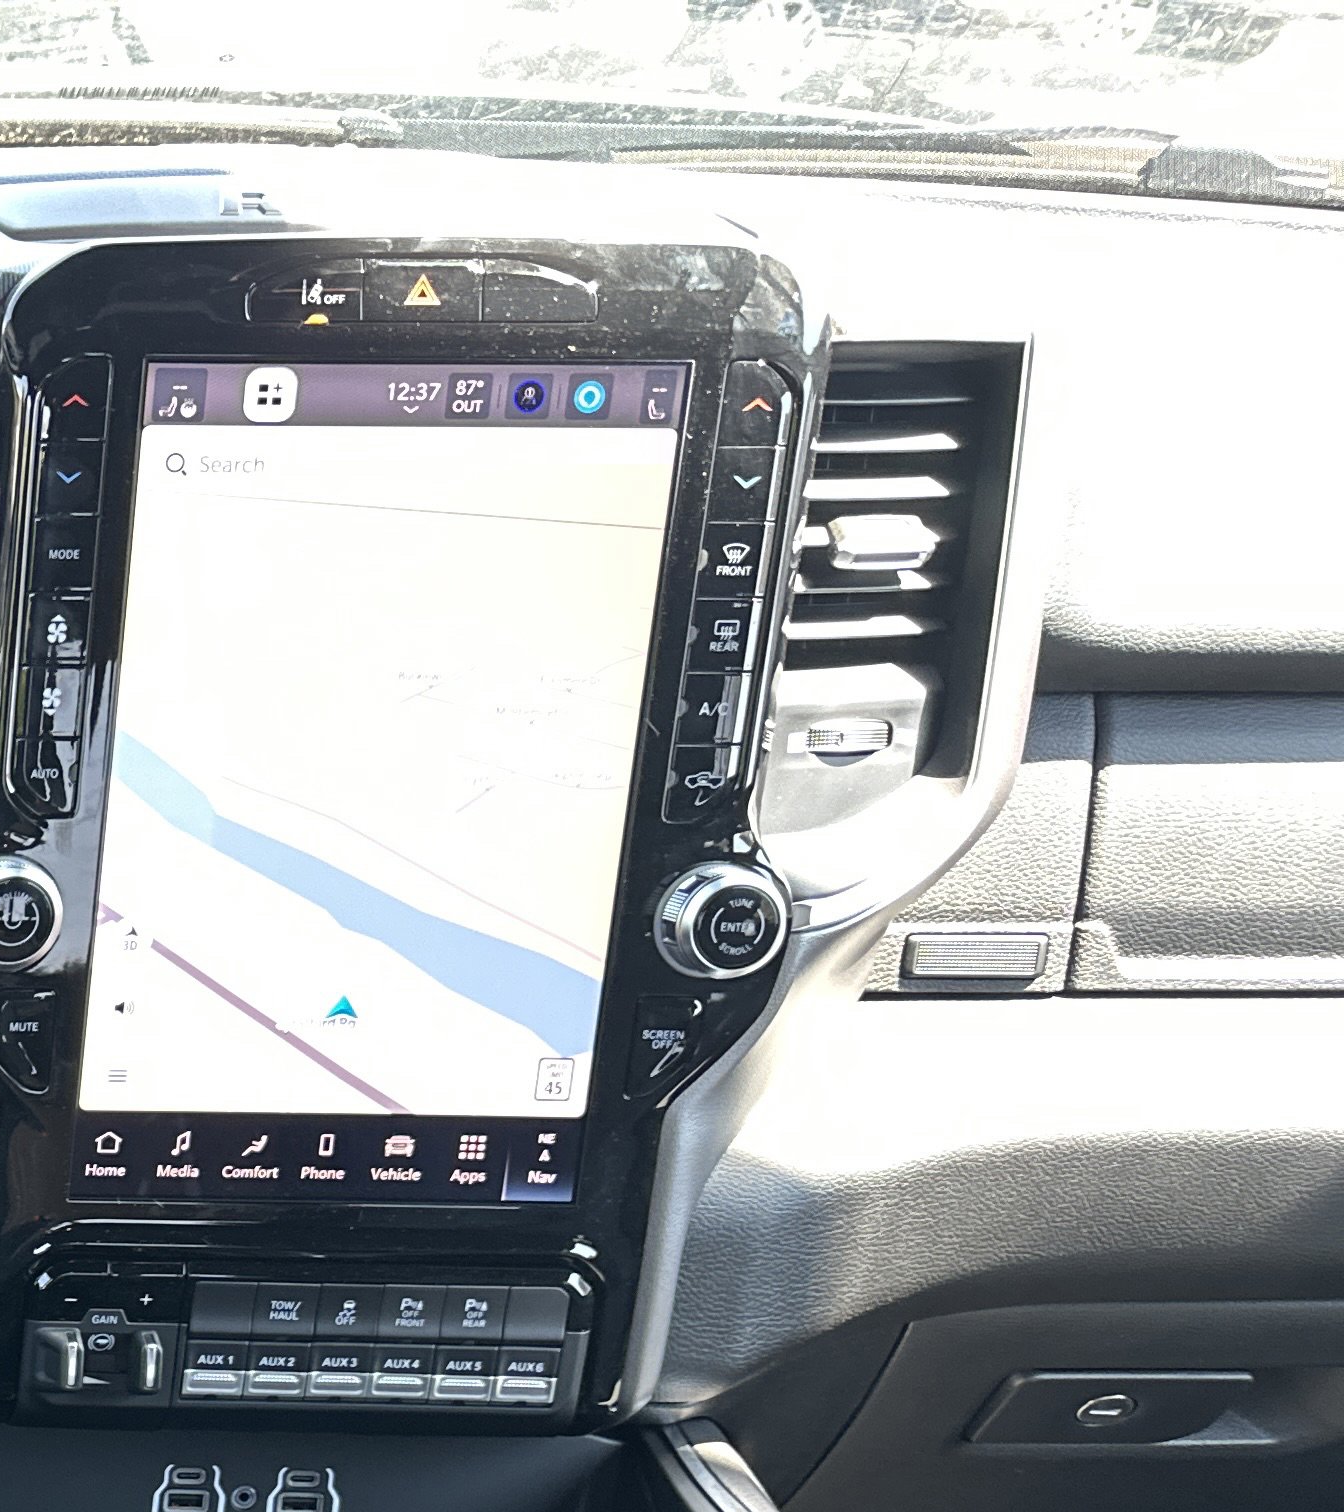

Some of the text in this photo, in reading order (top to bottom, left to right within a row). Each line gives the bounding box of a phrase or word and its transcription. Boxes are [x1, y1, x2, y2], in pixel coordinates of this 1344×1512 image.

[324, 291, 346, 305] OFF
[388, 382, 442, 402] 12:37
[455, 379, 484, 396] 87°
[452, 399, 483, 413] OUT
[199, 454, 265, 475] Search
[48, 548, 80, 560] MODE
[716, 565, 752, 577] FRONT
[709, 641, 739, 653] REAR
[698, 702, 728, 717] A/C
[30, 767, 59, 780] AUTO
[729, 899, 755, 911] TUNE
[123, 940, 138, 951] 3D
[718, 942, 753, 956] SCROLL
[9, 1021, 40, 1033] MUTE
[642, 1029, 685, 1041] SCREEN
[651, 1039, 673, 1050] OFF
[544, 1081, 562, 1095] 45
[537, 1133, 556, 1145] NE
[85, 1163, 126, 1178] Home
[156, 1164, 200, 1179] Media
[221, 1164, 279, 1180] Comfort
[300, 1165, 345, 1181] Phone
[370, 1166, 422, 1183] Vehicle
[449, 1168, 487, 1185] Apps
[527, 1170, 557, 1185] Nav
[270, 1300, 302, 1312] TOW/
[91, 1314, 118, 1325] GAIN
[269, 1311, 299, 1321] HAUL
[335, 1316, 356, 1326] OFF
[402, 1311, 419, 1319] OFF
[466, 1311, 483, 1319] OFF
[395, 1318, 425, 1328] FRONT
[463, 1319, 487, 1328] REAR
[197, 1354, 234, 1365] AUX 1
[259, 1356, 296, 1367] AUX 2
[322, 1357, 358, 1368] AUX 3
[384, 1358, 420, 1369] AUX 4
[446, 1361, 482, 1372] AUX 5
[508, 1362, 544, 1373] AUX 6
